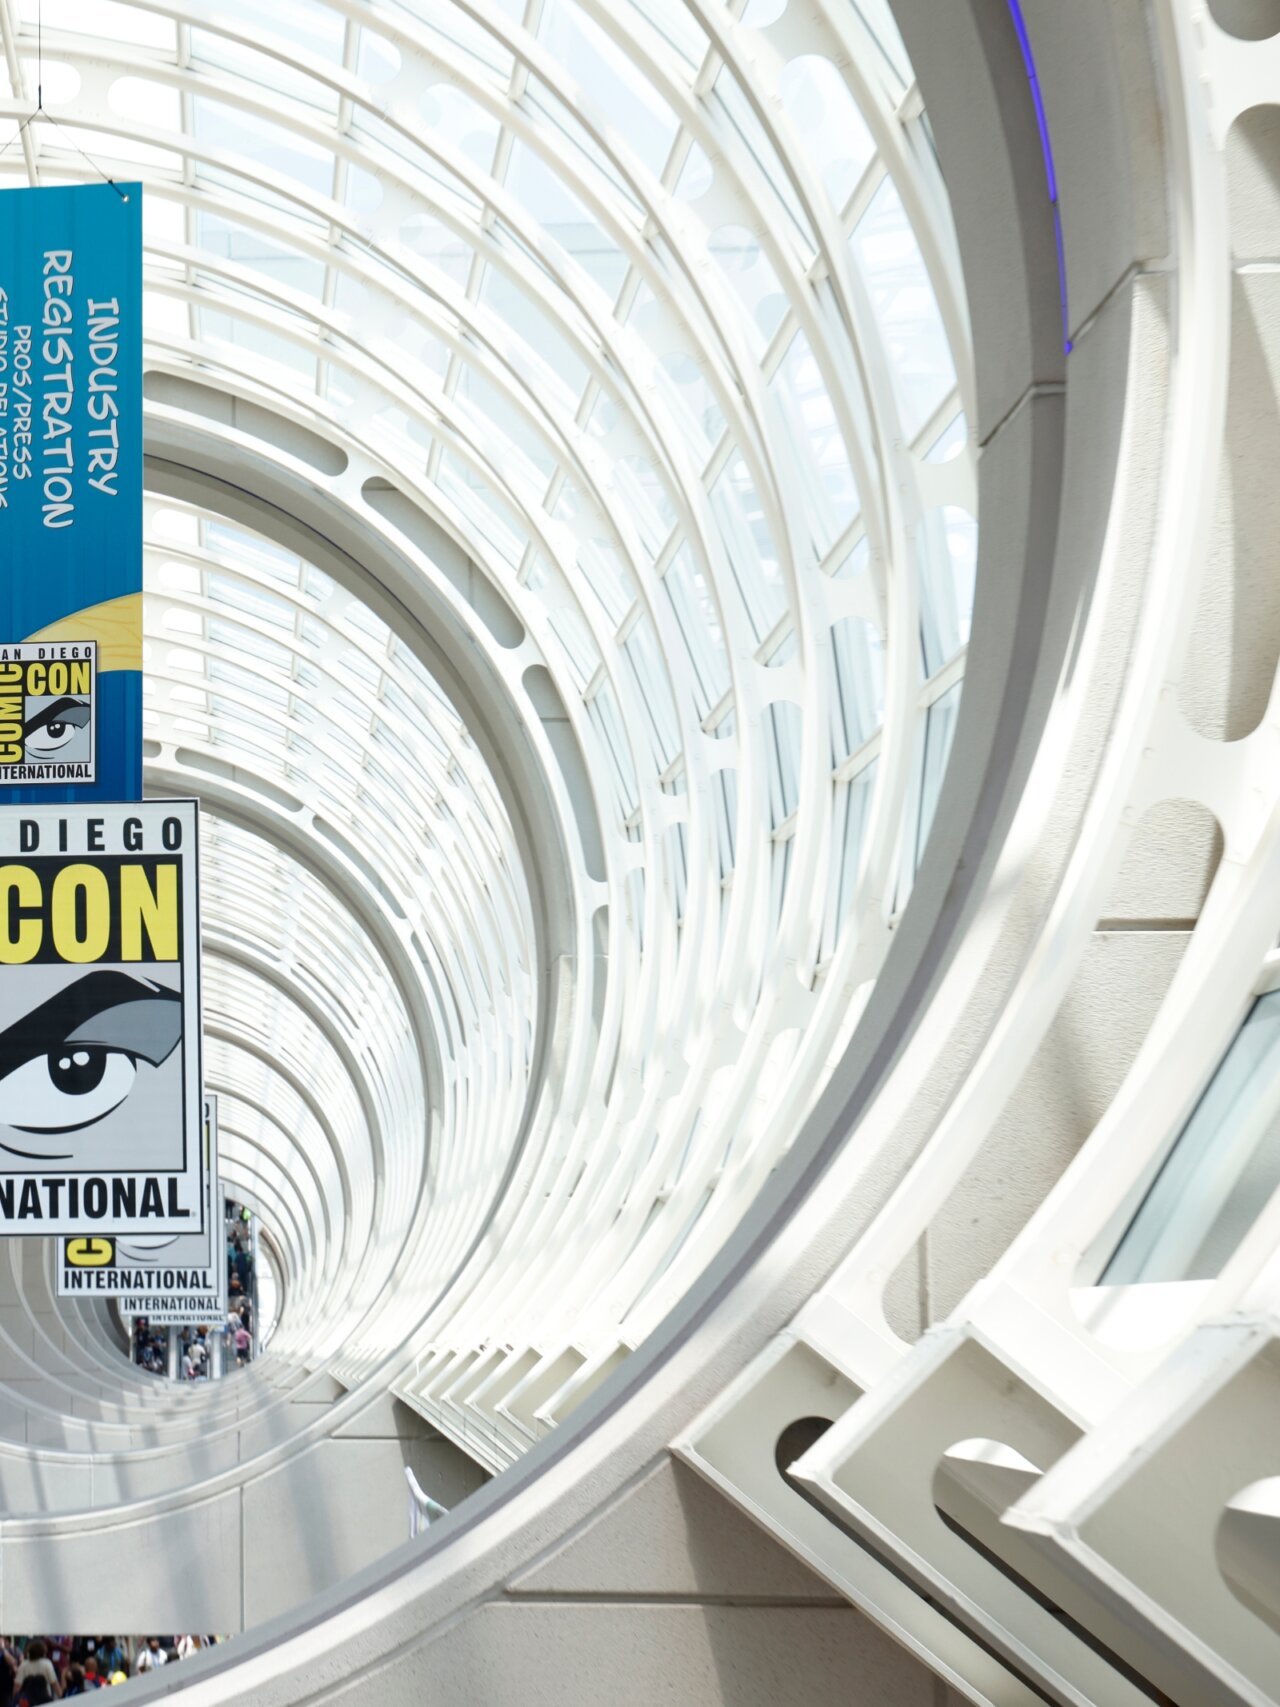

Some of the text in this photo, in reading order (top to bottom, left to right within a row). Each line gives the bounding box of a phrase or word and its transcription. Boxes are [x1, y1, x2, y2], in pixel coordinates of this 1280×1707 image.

[13, 325, 32, 480] PROS/PRESS
[42, 250, 74, 528] REGISTRATION
[87, 297, 119, 496] INDUSTRY
[38, 647, 92, 660] DIEGO
[26, 662, 90, 696] CON
[21, 816, 183, 853] DIEGO
[64, 1270, 212, 1289] INTERNATIONAL
[125, 1297, 221, 1311] INTERNATIONAL
